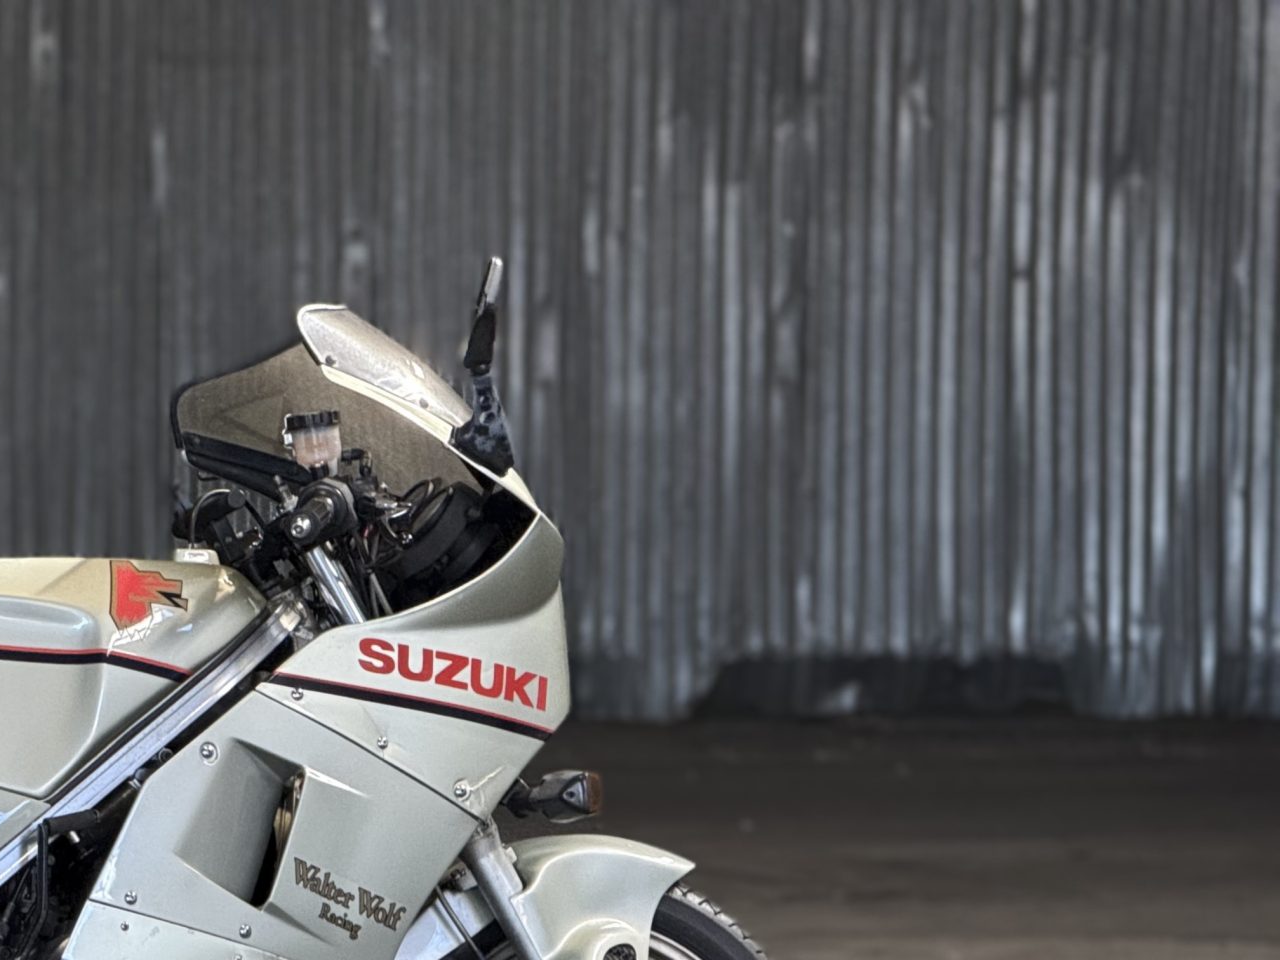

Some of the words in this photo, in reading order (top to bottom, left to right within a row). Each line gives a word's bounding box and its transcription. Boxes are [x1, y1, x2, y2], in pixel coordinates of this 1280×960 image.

[358, 637, 548, 712] SUZUKI
[294, 856, 355, 909] Walter
[358, 886, 407, 931] Wolf
[318, 902, 362, 940] Racing
